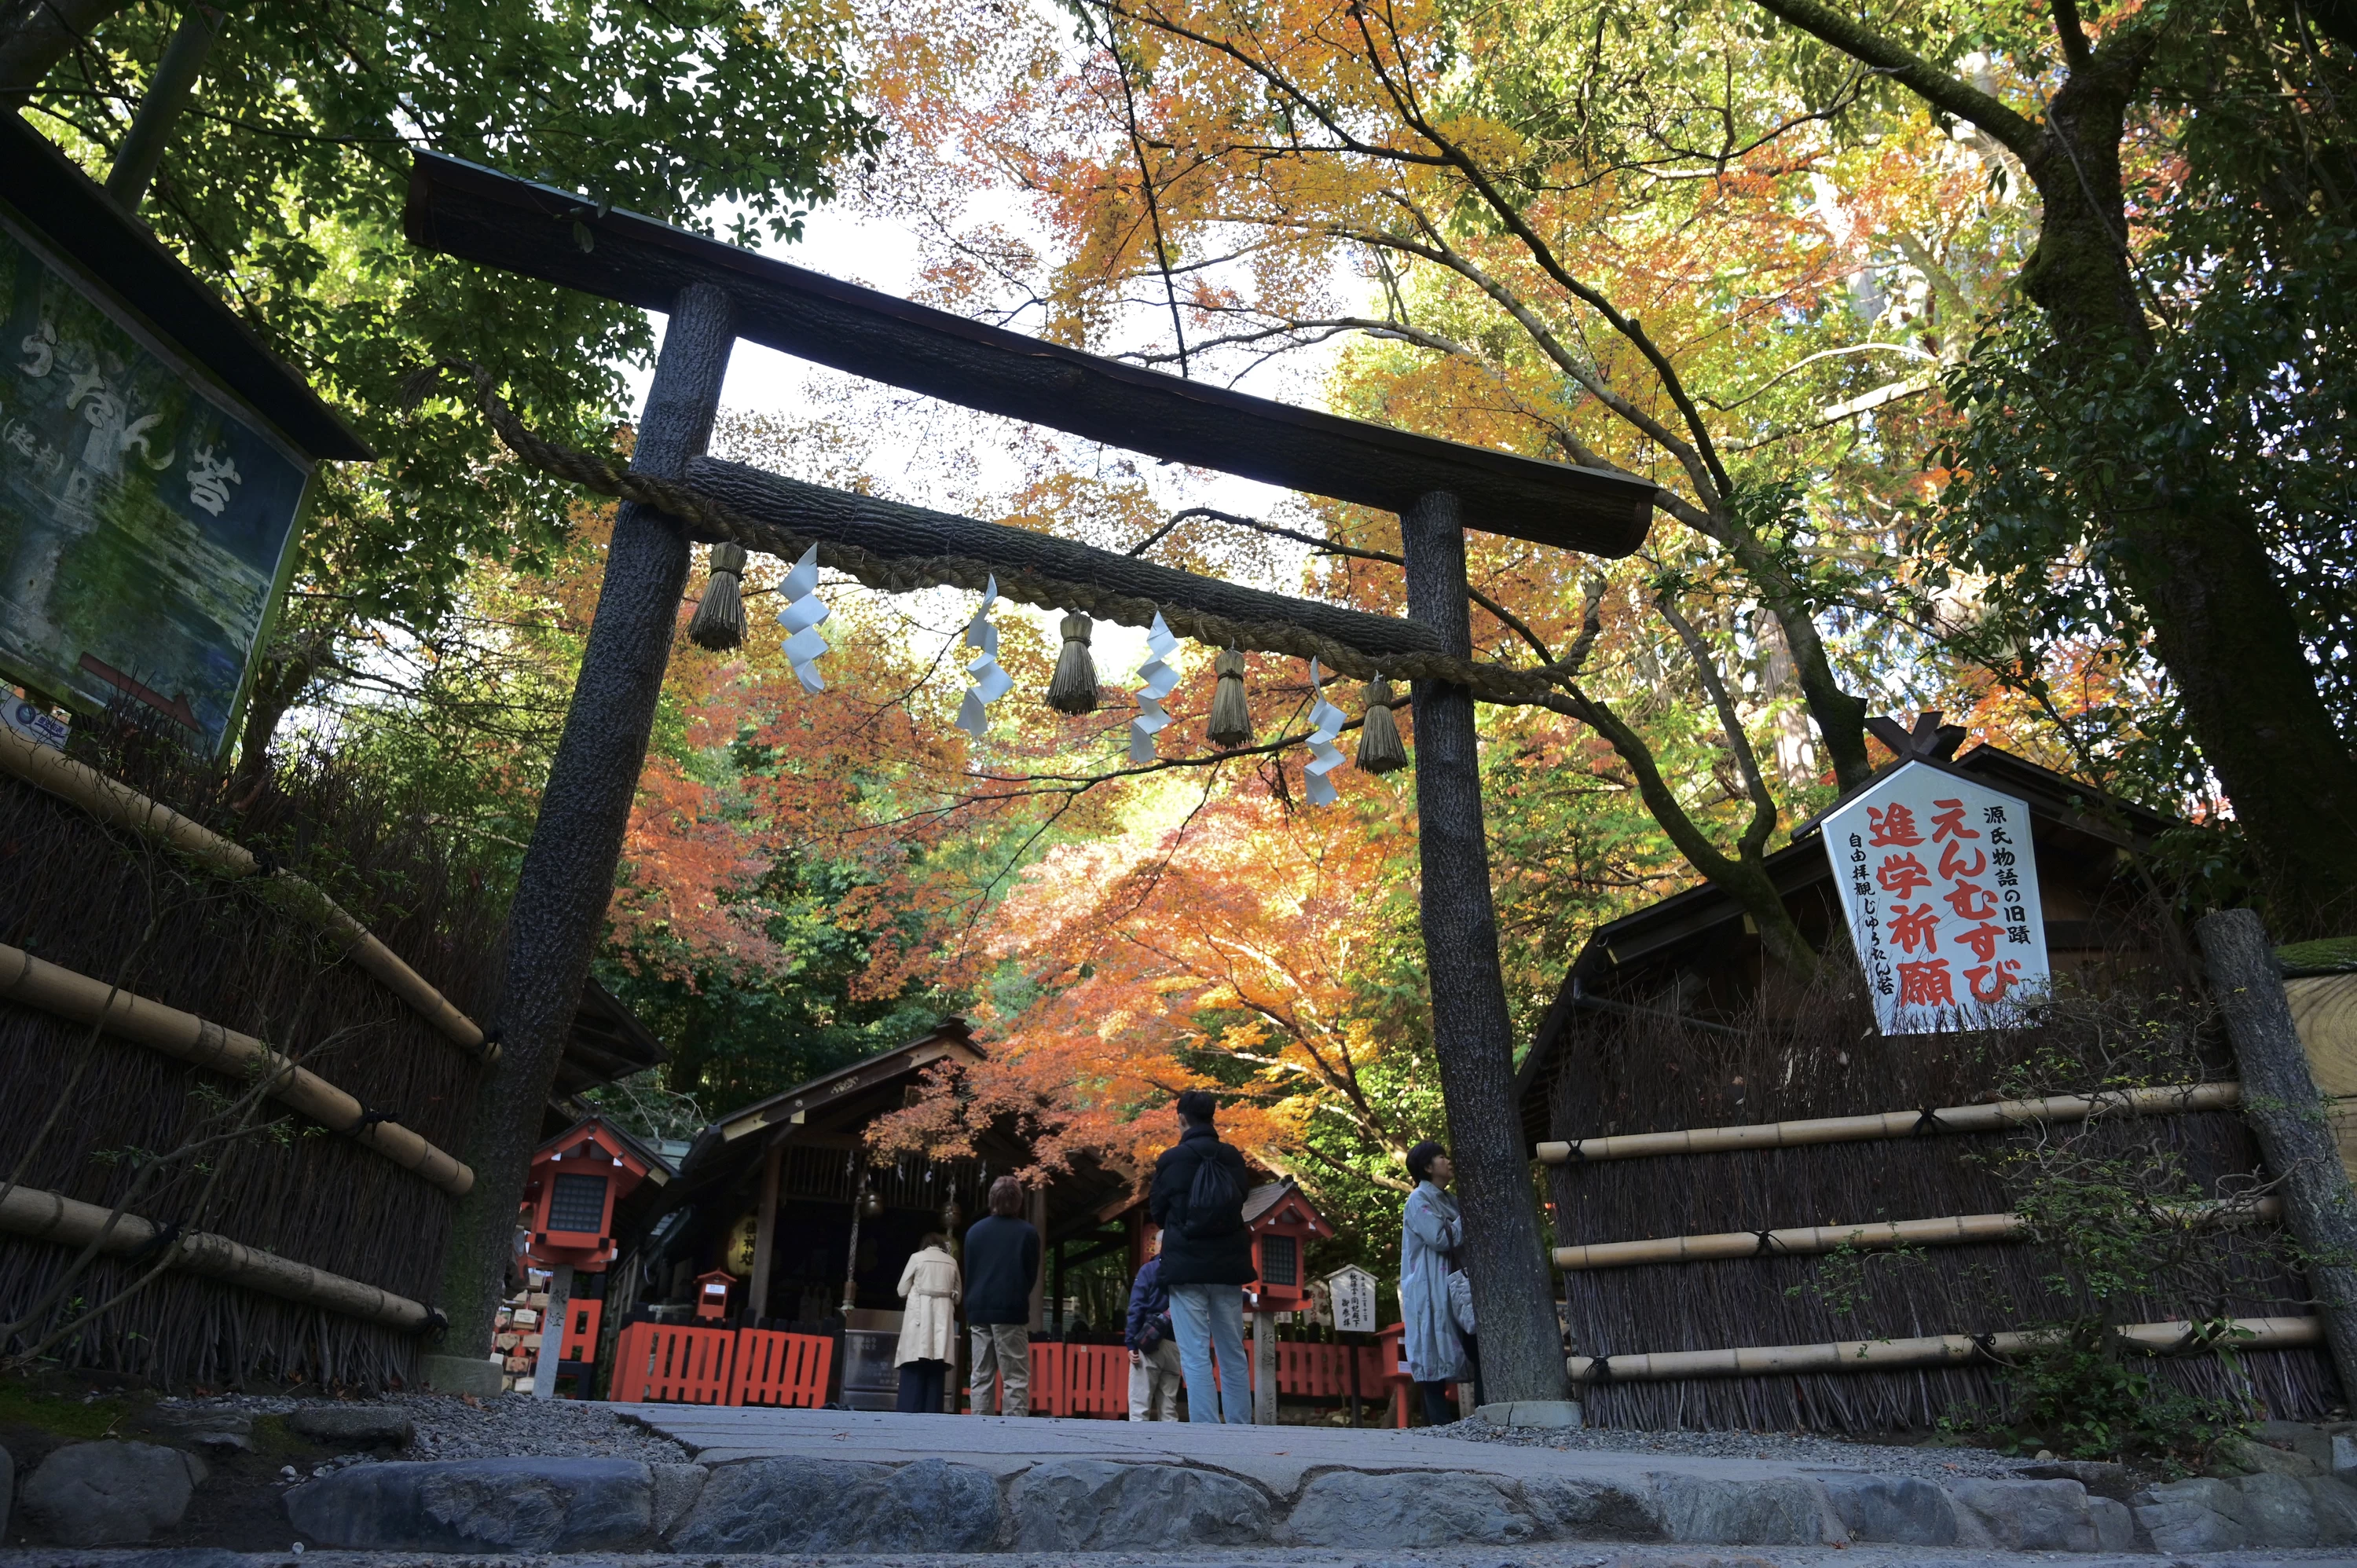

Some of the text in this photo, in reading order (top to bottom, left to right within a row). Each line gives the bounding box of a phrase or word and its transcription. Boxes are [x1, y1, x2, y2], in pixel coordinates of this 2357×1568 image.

[1866, 802, 1956, 1008] 進学祈願
[1930, 798, 2022, 1002] えんむすび
[1983, 805, 2031, 945] 源氏物語の旧蹟
